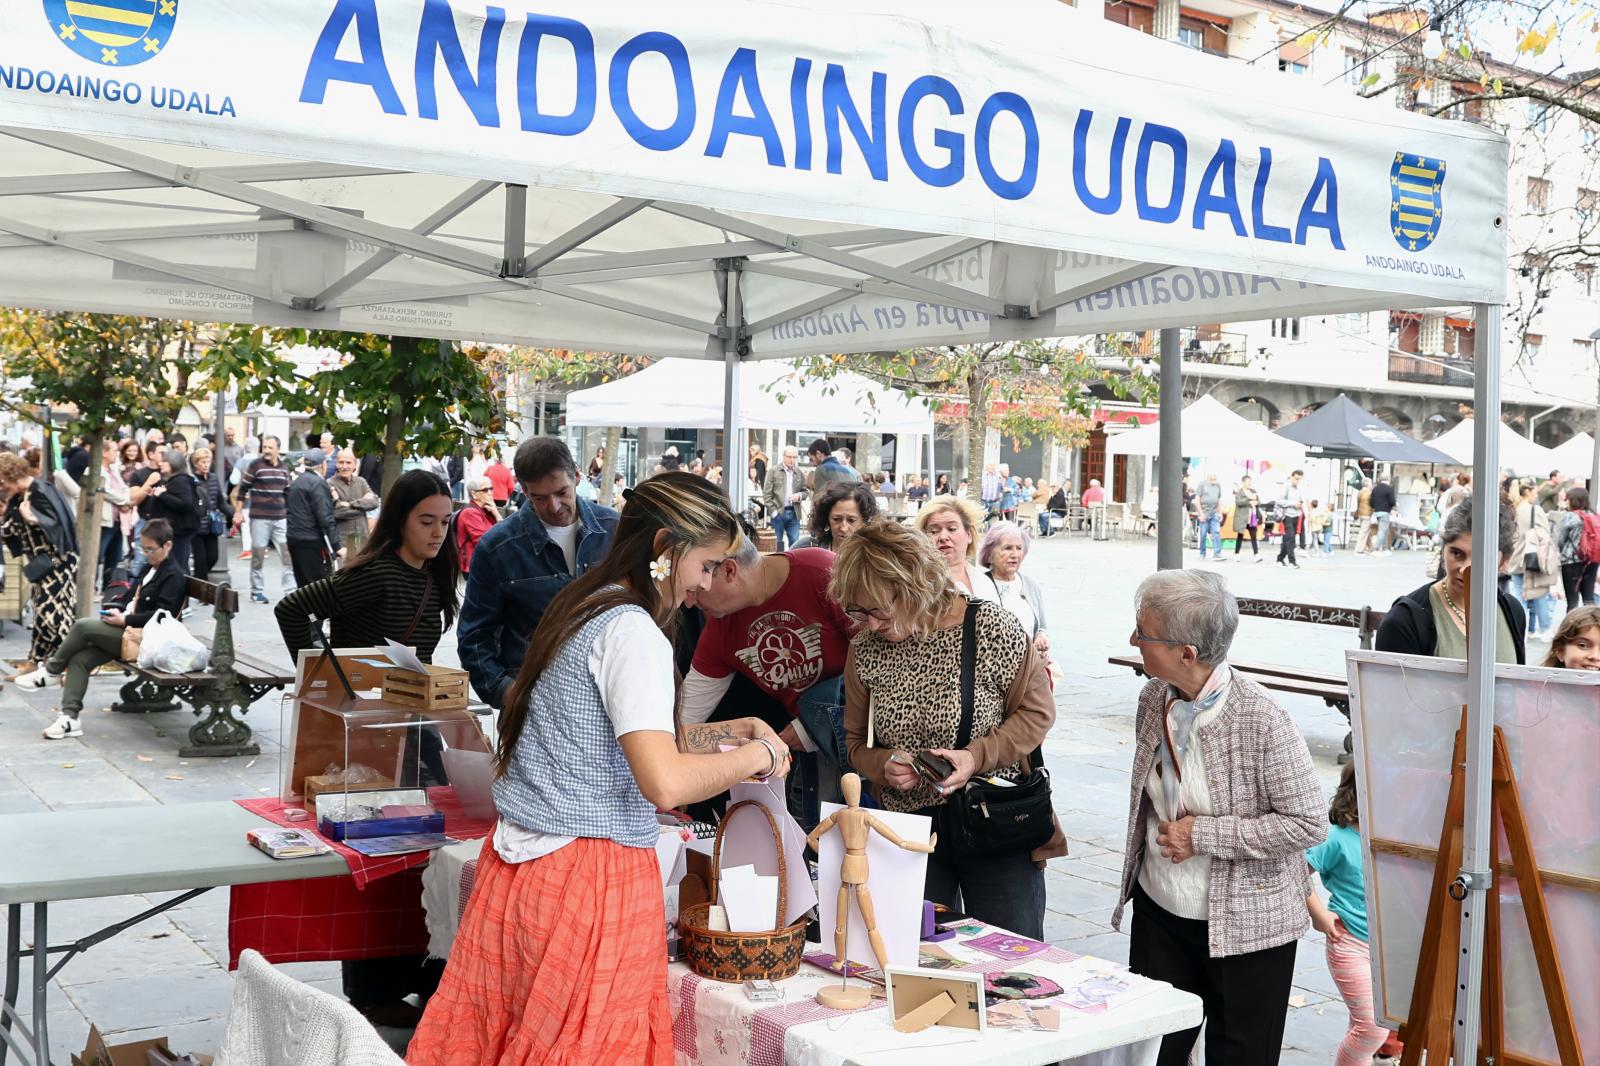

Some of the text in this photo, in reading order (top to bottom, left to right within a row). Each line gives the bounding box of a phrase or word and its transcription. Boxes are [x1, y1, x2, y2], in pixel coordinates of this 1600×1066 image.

[151, 86, 237, 118] UDALA
[299, 0, 1346, 251] ANDOAINGO UDALA
[1365, 254, 1466, 281] ANDOAINGO UDALA
